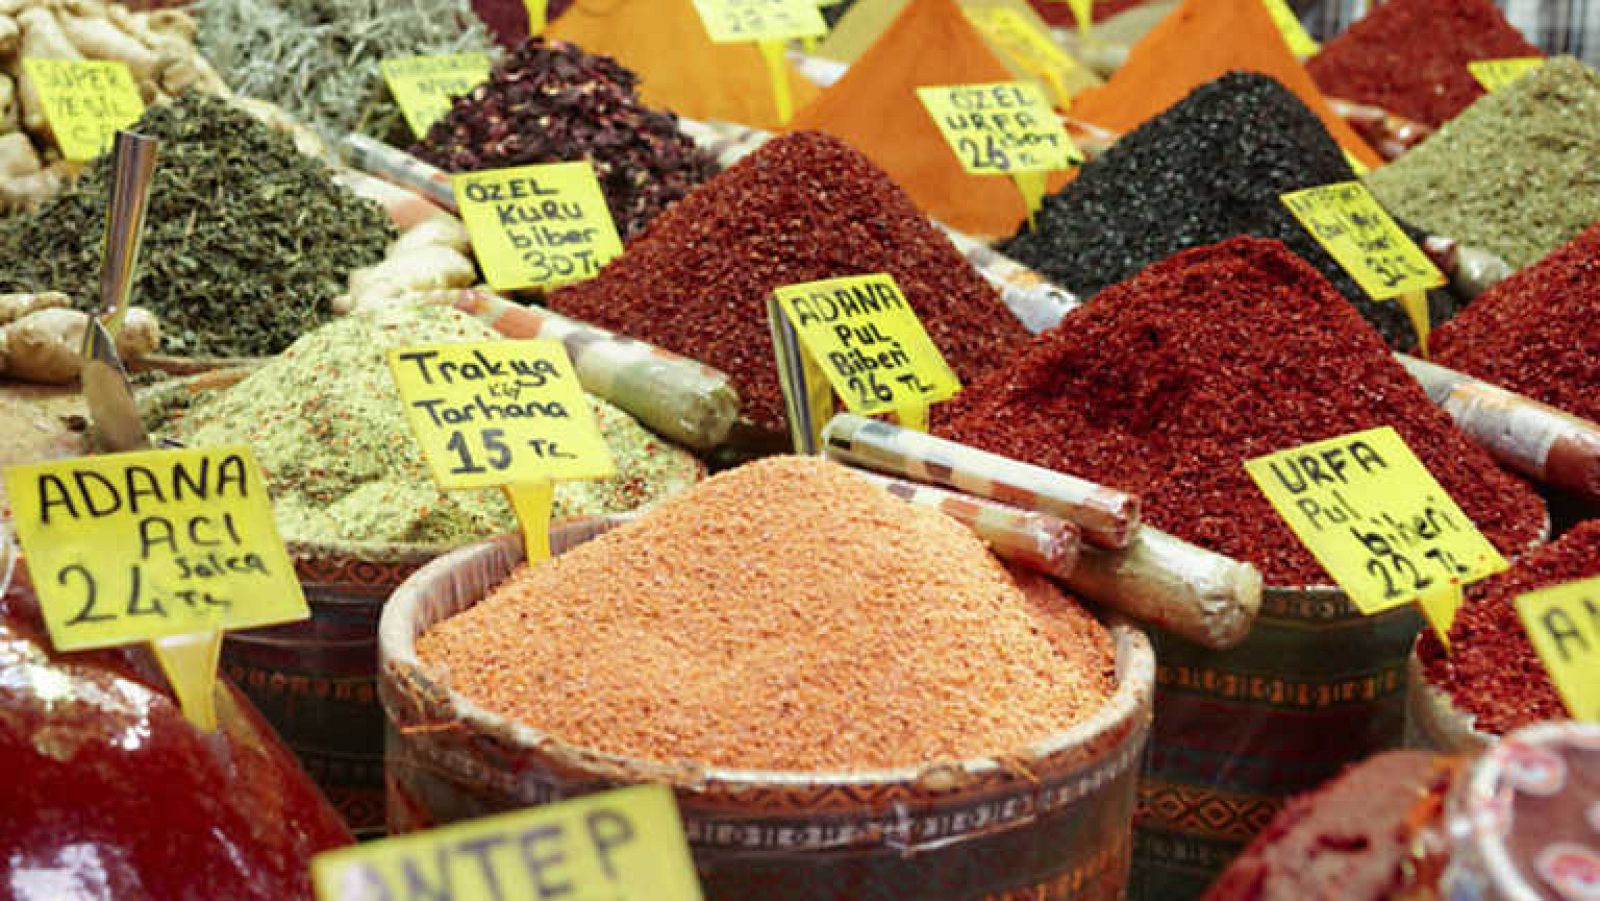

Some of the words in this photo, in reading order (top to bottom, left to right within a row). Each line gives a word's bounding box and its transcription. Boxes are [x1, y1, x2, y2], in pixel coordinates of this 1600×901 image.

[791, 281, 902, 326] ADANA
[400, 350, 561, 386] Trakya
[412, 395, 568, 428] Tarhana
[848, 374, 893, 409] 26
[447, 428, 512, 474] 15
[1269, 441, 1387, 494] URFA
[37, 454, 248, 525] ADANA
[139, 513, 242, 560] ACI
[57, 564, 168, 627] 24
[1366, 554, 1432, 598] 22
